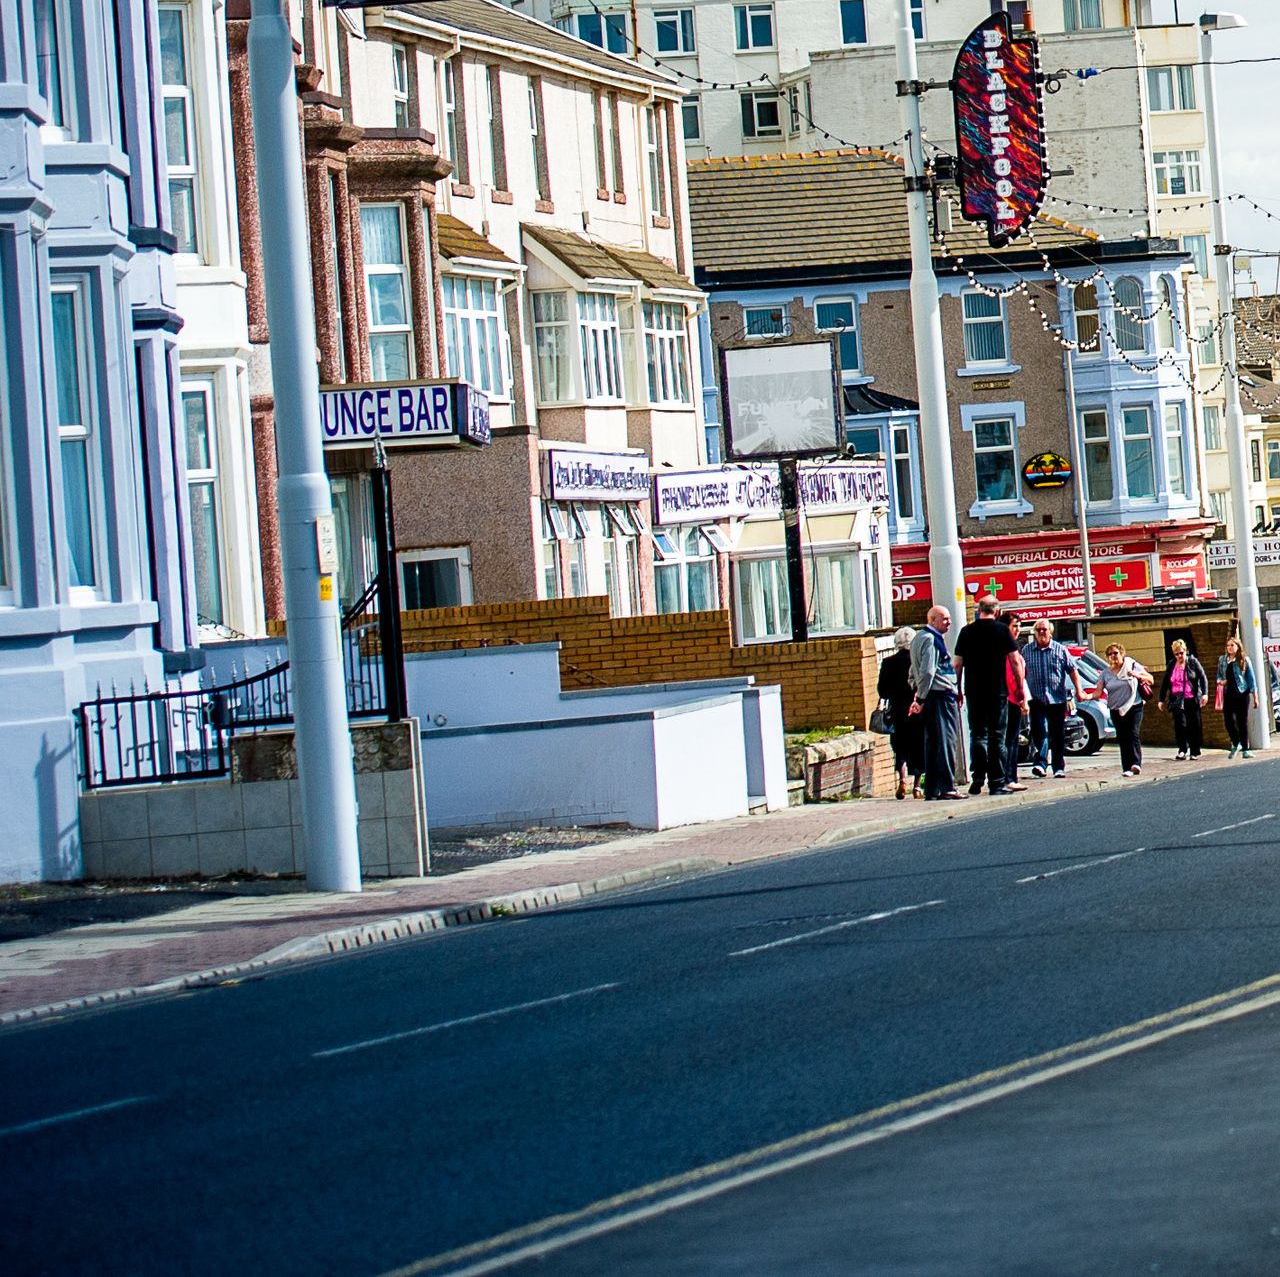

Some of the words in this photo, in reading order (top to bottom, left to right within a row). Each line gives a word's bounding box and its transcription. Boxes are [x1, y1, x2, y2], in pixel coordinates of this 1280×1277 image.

[982, 29, 1016, 220] BLACKPOOL
[322, 389, 393, 437] UNGE
[398, 387, 450, 432] BAR
[993, 551, 1048, 564] IMPERIAL
[1025, 568, 1061, 578] Souvenirs
[1061, 567, 1068, 575] &
